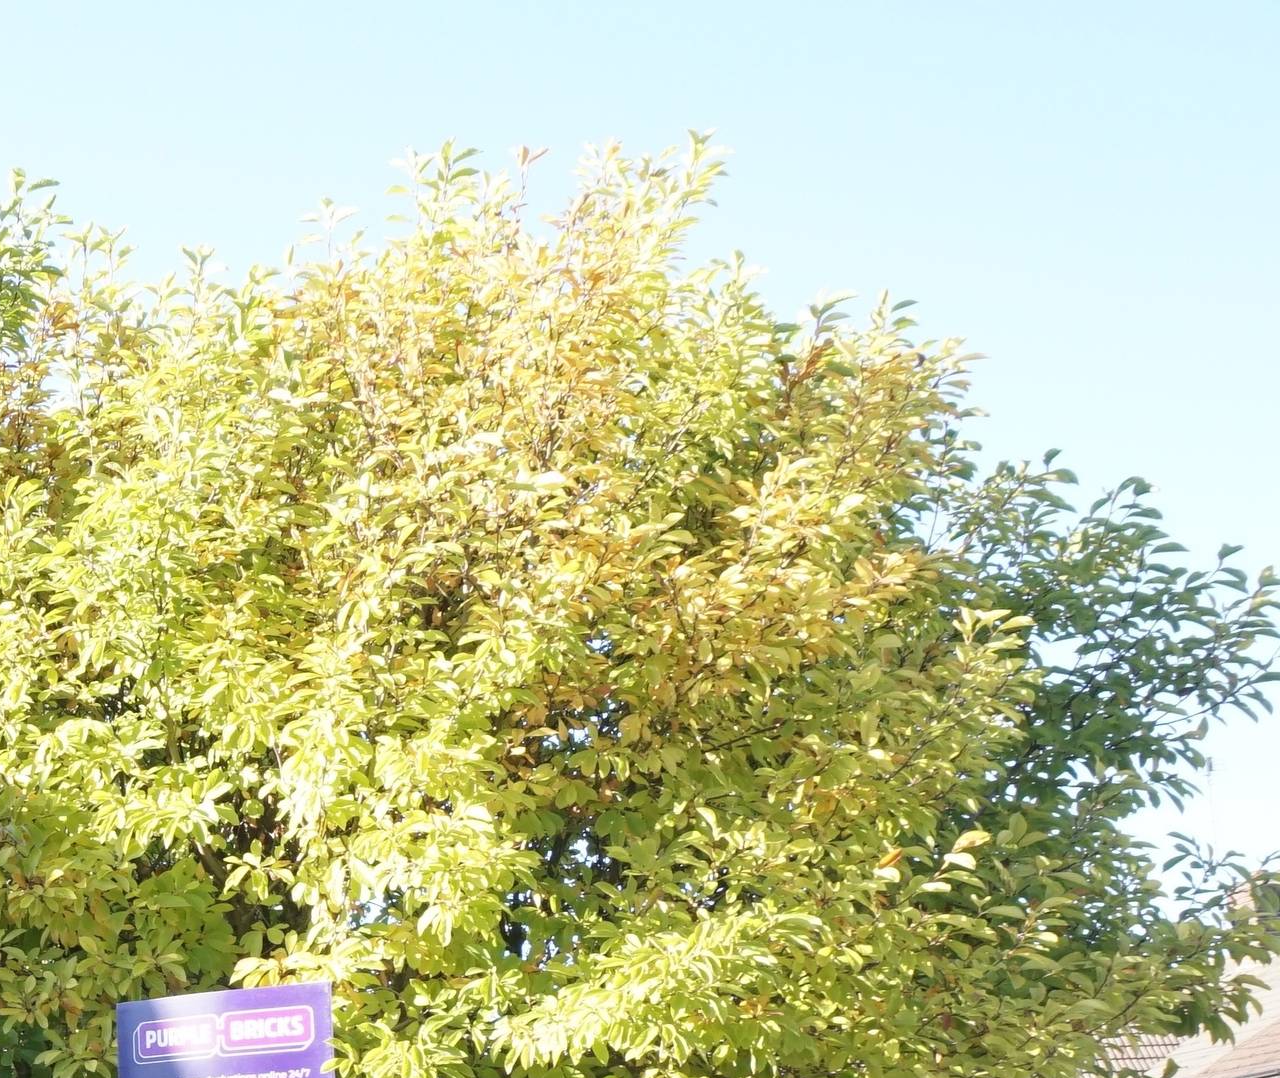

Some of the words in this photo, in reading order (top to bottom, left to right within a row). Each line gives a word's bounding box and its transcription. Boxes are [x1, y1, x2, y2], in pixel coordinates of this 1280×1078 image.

[145, 1023, 212, 1049] PURPLE
[230, 1015, 304, 1041] BRICKS
[288, 1068, 311, 1078] 24/7
